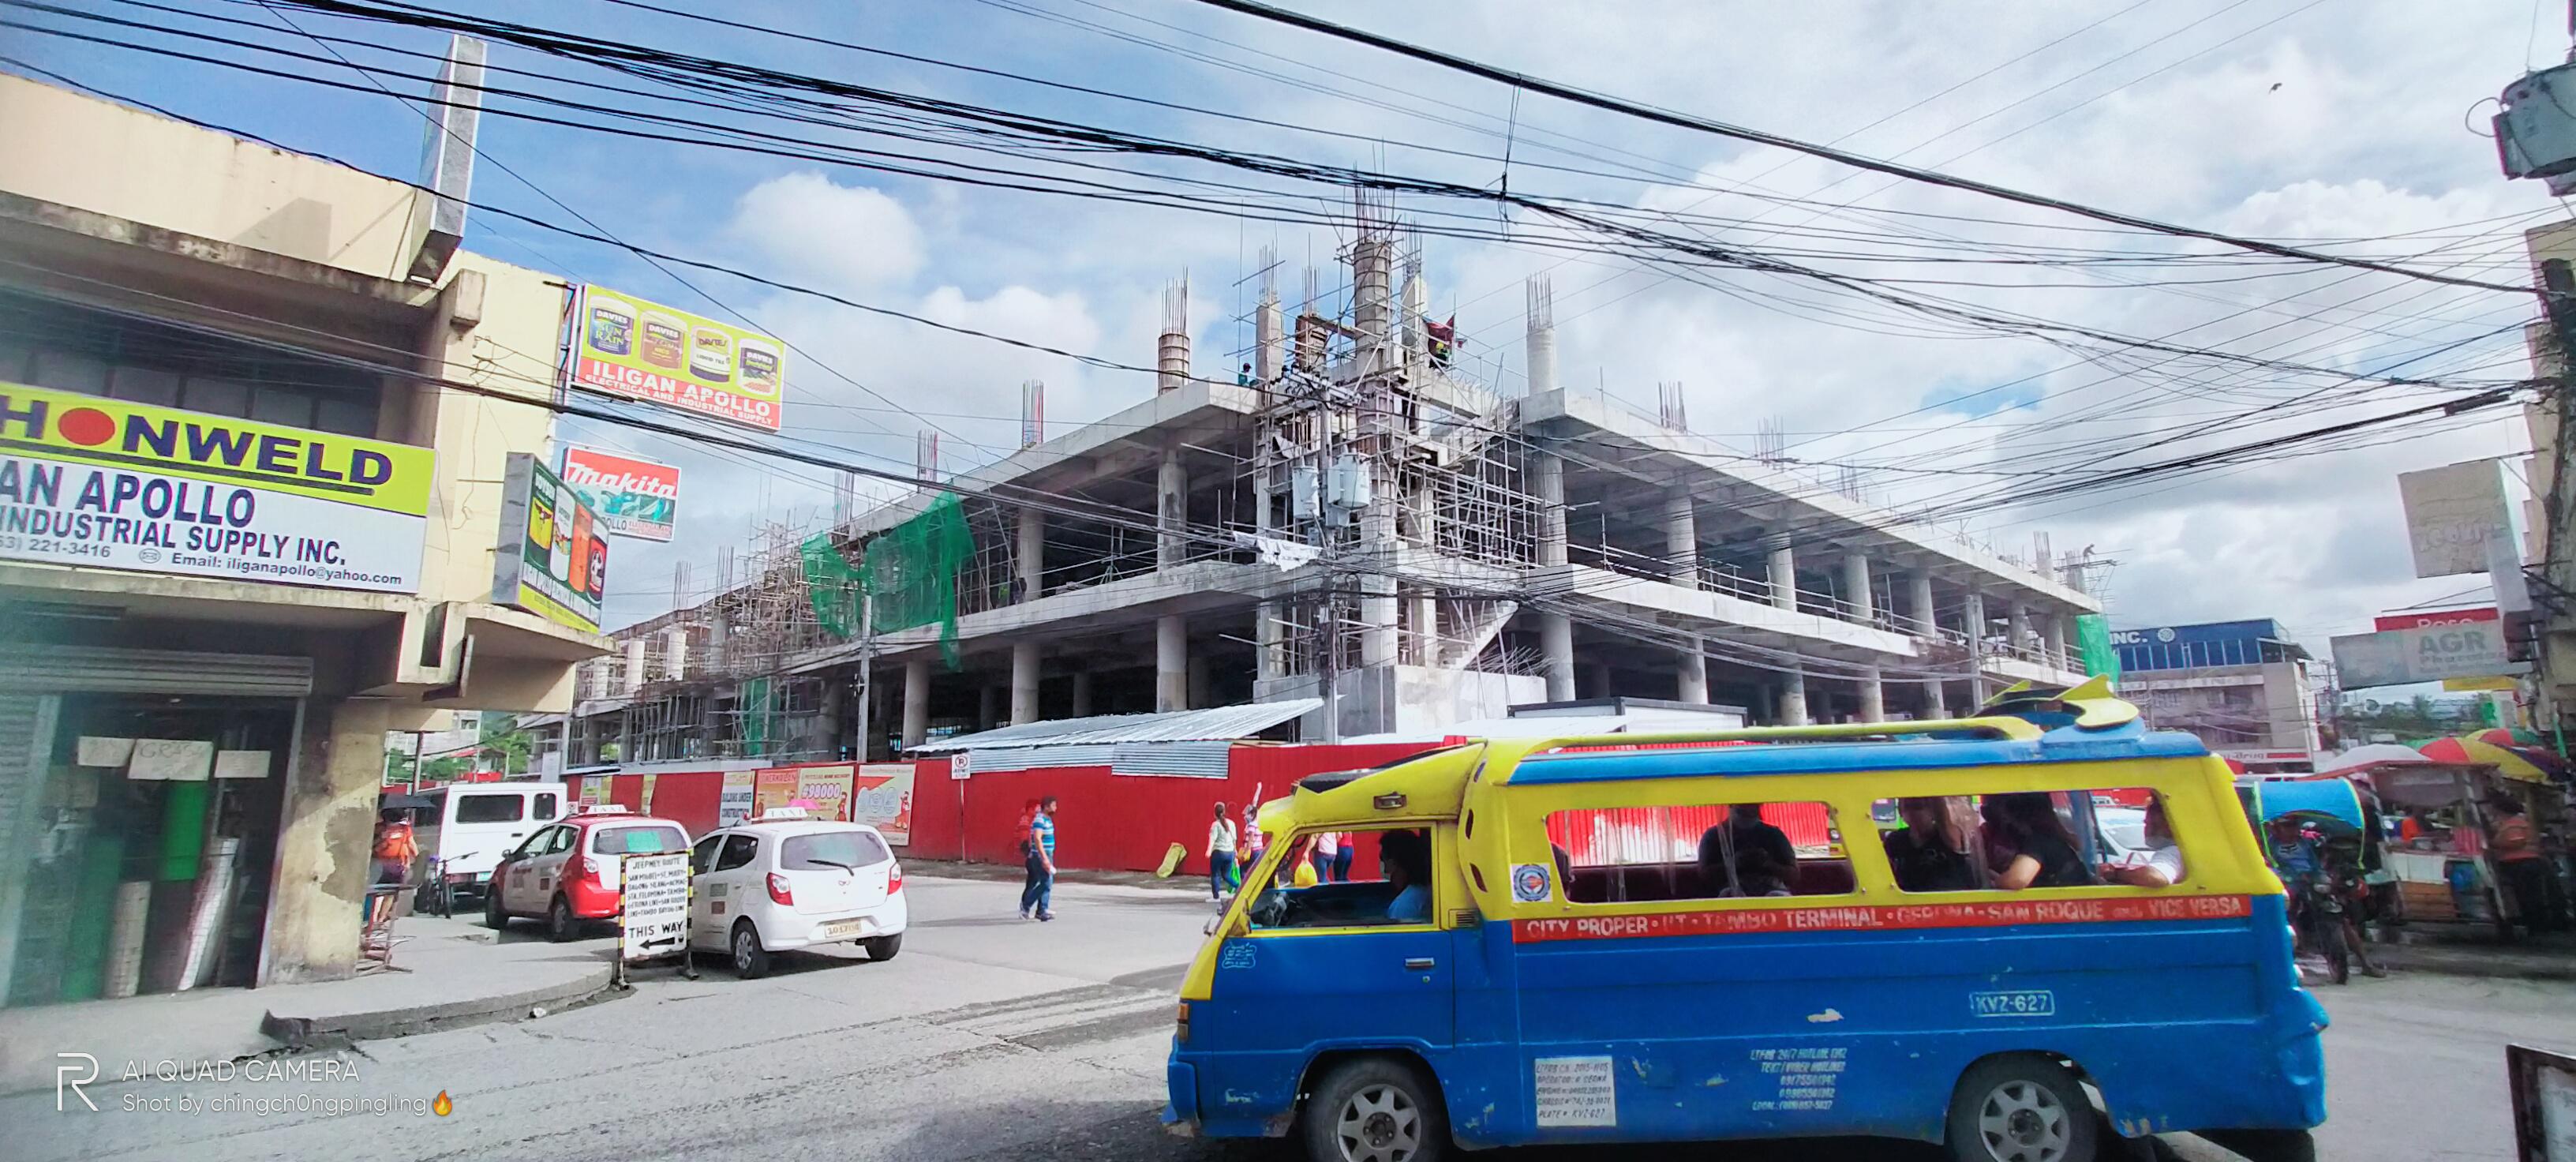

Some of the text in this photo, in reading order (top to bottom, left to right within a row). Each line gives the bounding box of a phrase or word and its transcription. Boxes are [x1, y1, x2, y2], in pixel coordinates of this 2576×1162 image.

[585, 373, 773, 425] ELECTRICAL AND INDUSTRIAL SUPPLY
[592, 360, 771, 417] ILIGAN APOLLO
[75, 470, 256, 528] APOLLO
[28, 538, 110, 558] 221-3416
[186, 526, 290, 560] SUPPLY
[297, 538, 346, 566] INC.
[171, 553, 402, 586] Email: iliganapollo@yahoo.com
[629, 920, 683, 939] THIS WAY
[1527, 920, 1569, 938] CITY
[1577, 916, 1649, 936] PROPER
[1784, 909, 1884, 928] TERMINAL
[1987, 905, 2031, 920] SAN
[2036, 901, 2103, 920] ROQUE
[2147, 899, 2185, 917] VICE
[2188, 897, 2242, 916] VERSA
[1975, 995, 2047, 1013] KVZ-627
